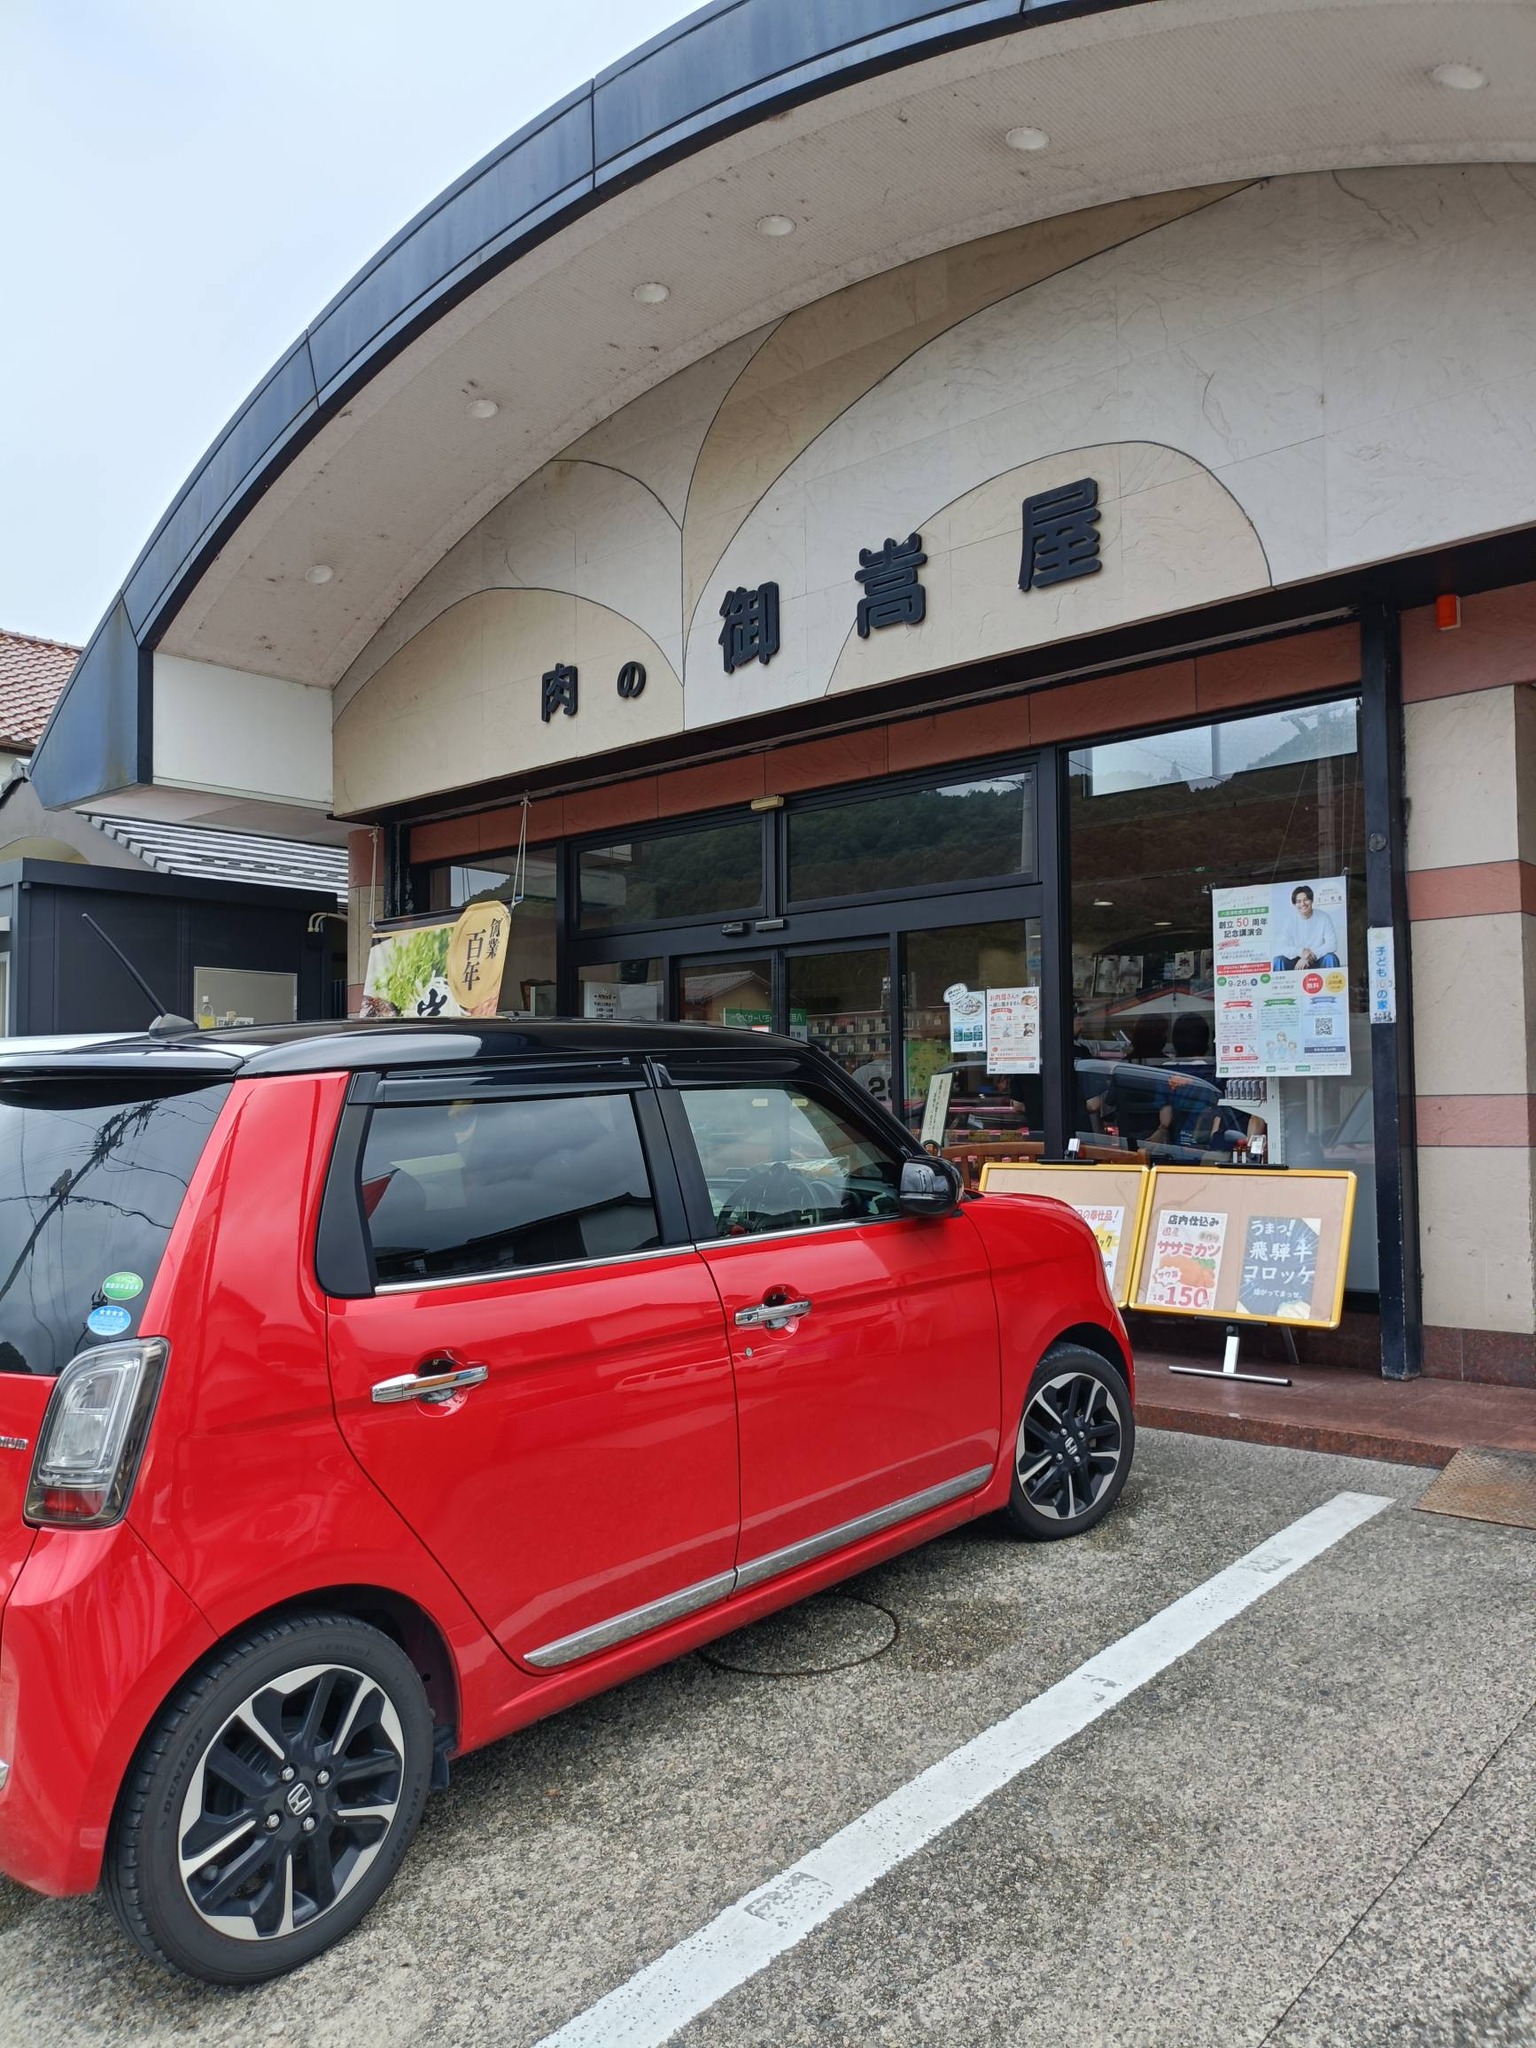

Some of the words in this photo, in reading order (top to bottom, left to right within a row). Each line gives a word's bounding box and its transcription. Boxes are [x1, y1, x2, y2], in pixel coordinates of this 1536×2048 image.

[485, 918, 503, 959] 創業
[1224, 929, 1263, 938] 記念講演会
[462, 929, 486, 991] 百年
[1168, 1214, 1219, 1227] 店内仕込み
[1251, 1219, 1296, 1236] うまっ!
[1157, 1240, 1222, 1258] ササミカツ
[1243, 1265, 1316, 1285] コロッケ
